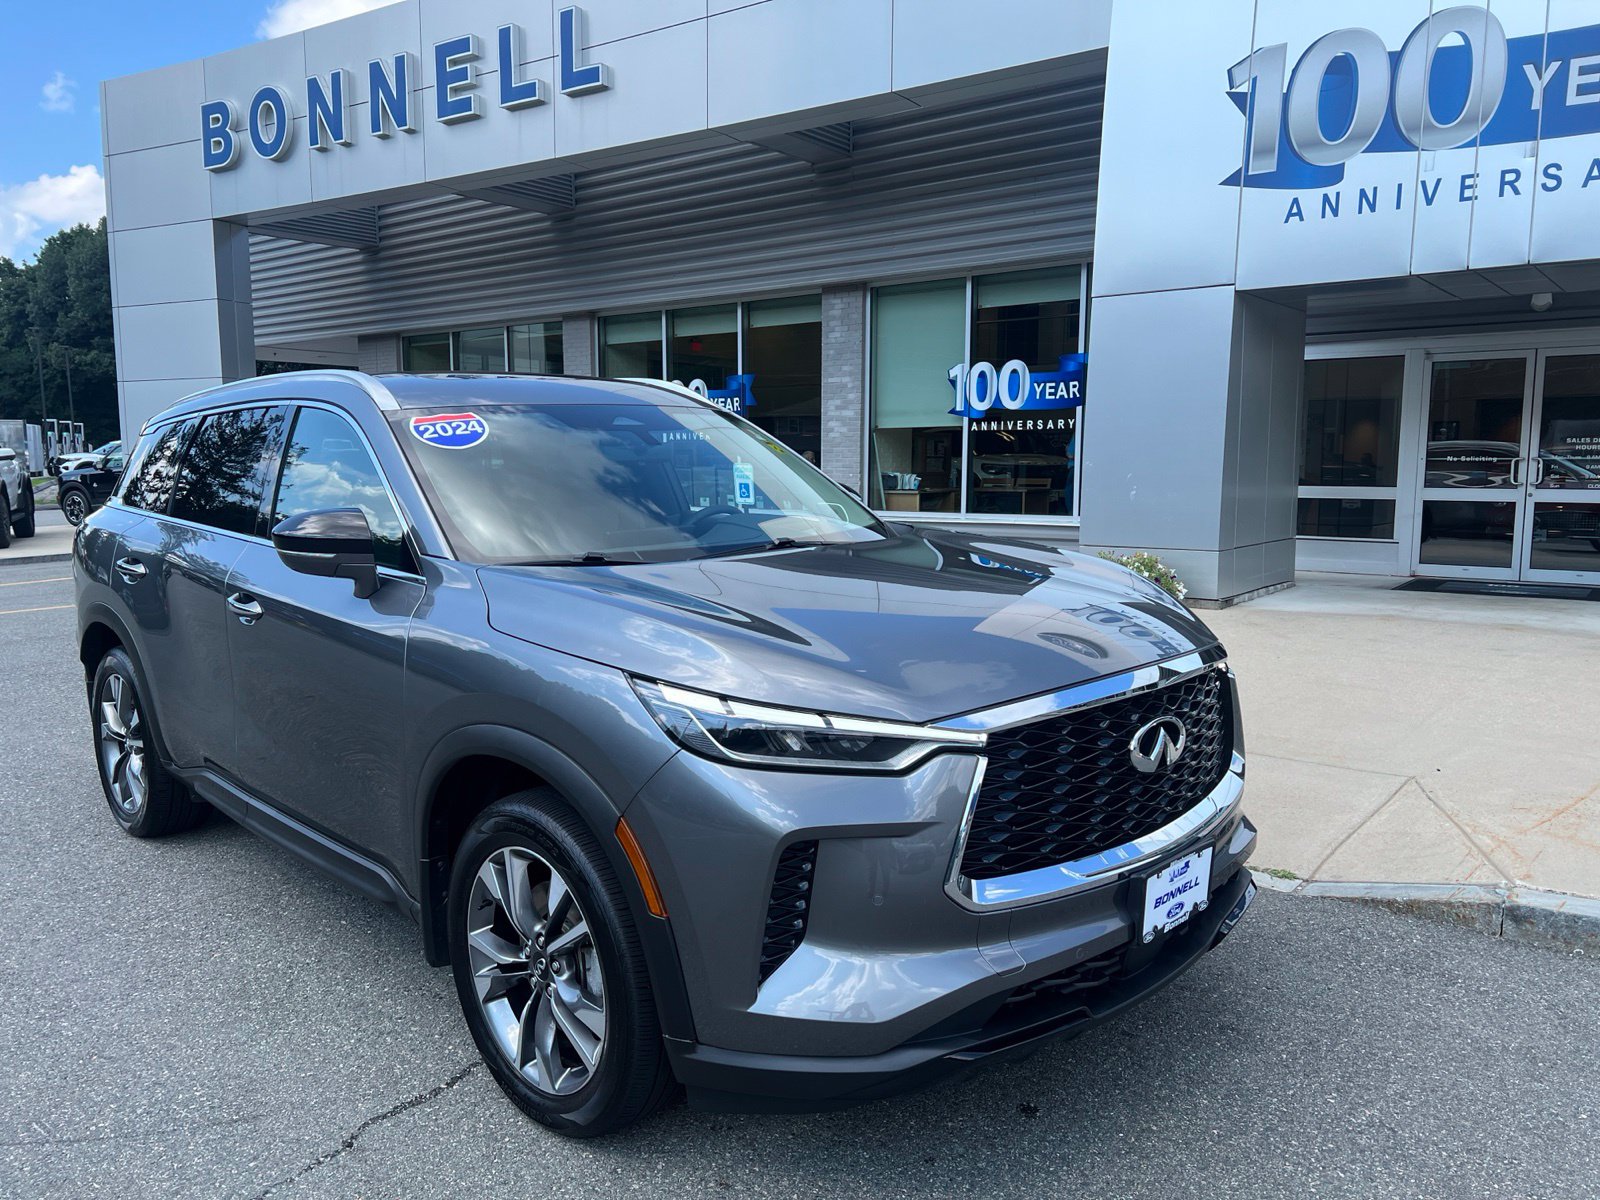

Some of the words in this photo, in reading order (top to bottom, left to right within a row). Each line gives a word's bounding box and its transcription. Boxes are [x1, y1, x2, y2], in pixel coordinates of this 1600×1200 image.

[201, 5, 609, 172] BONNELL
[1227, 5, 1508, 175] 100
[1283, 157, 1600, 224] ANNIVERSA
[948, 359, 1031, 411] 100
[1033, 380, 1080, 400] YEAR
[418, 420, 484, 439] 2024
[970, 418, 1075, 431] ANNIVERSARY
[1460, 455, 1498, 463] Soliciting
[1153, 876, 1200, 910] BONNELL
